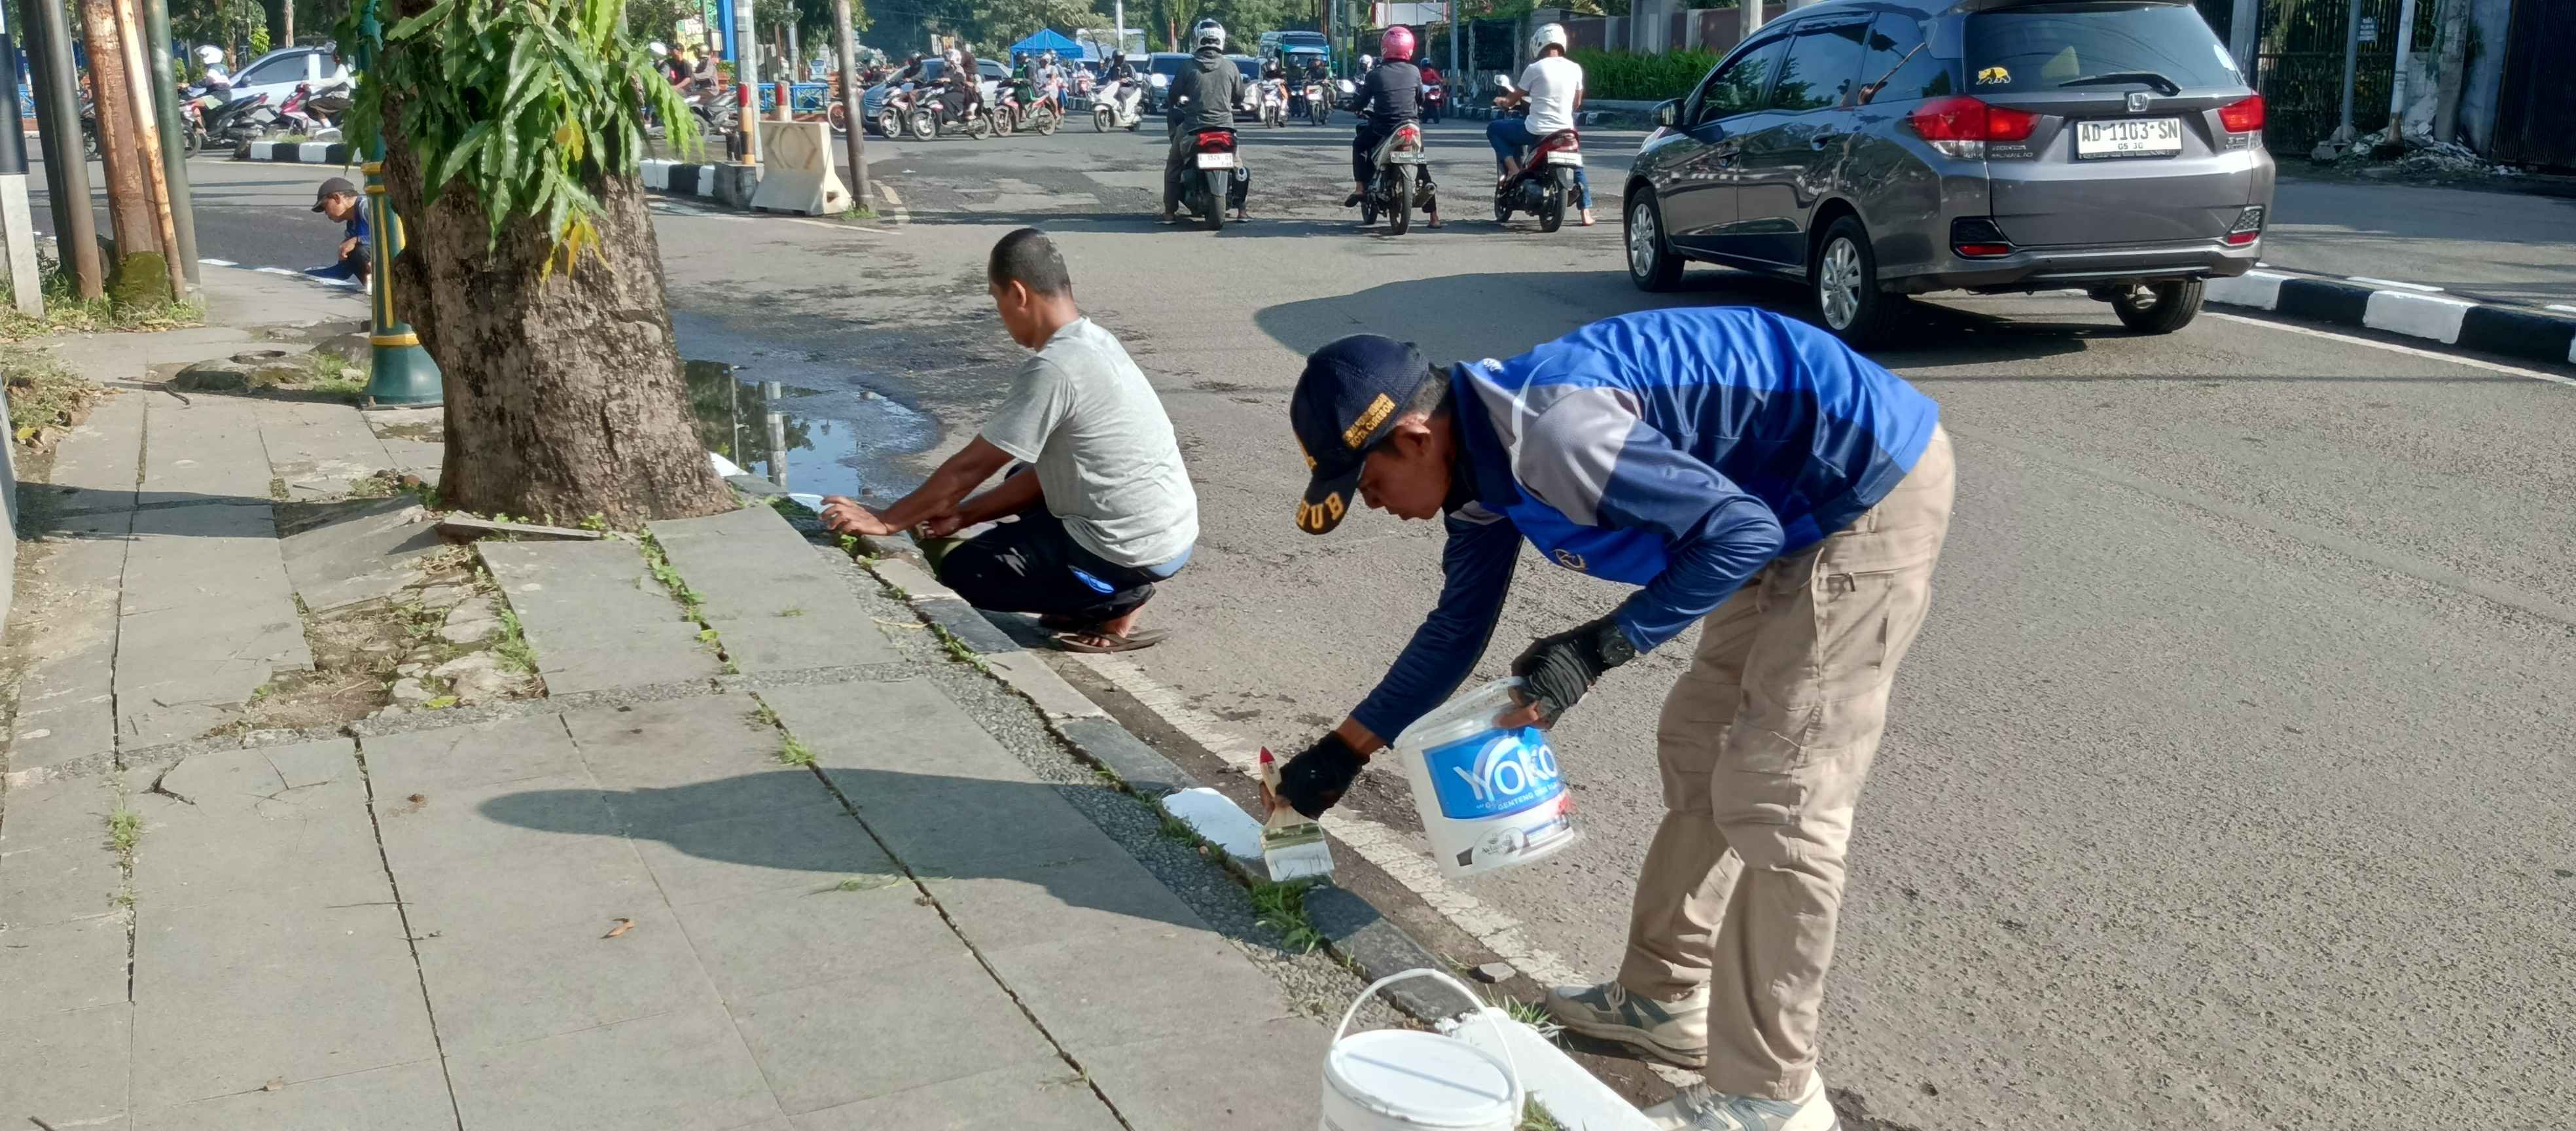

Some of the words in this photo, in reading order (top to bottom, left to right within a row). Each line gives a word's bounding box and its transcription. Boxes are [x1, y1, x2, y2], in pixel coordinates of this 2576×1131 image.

[2082, 123, 2101, 142] AD
[2109, 121, 2149, 141] 1103
[2158, 120, 2178, 139] SN
